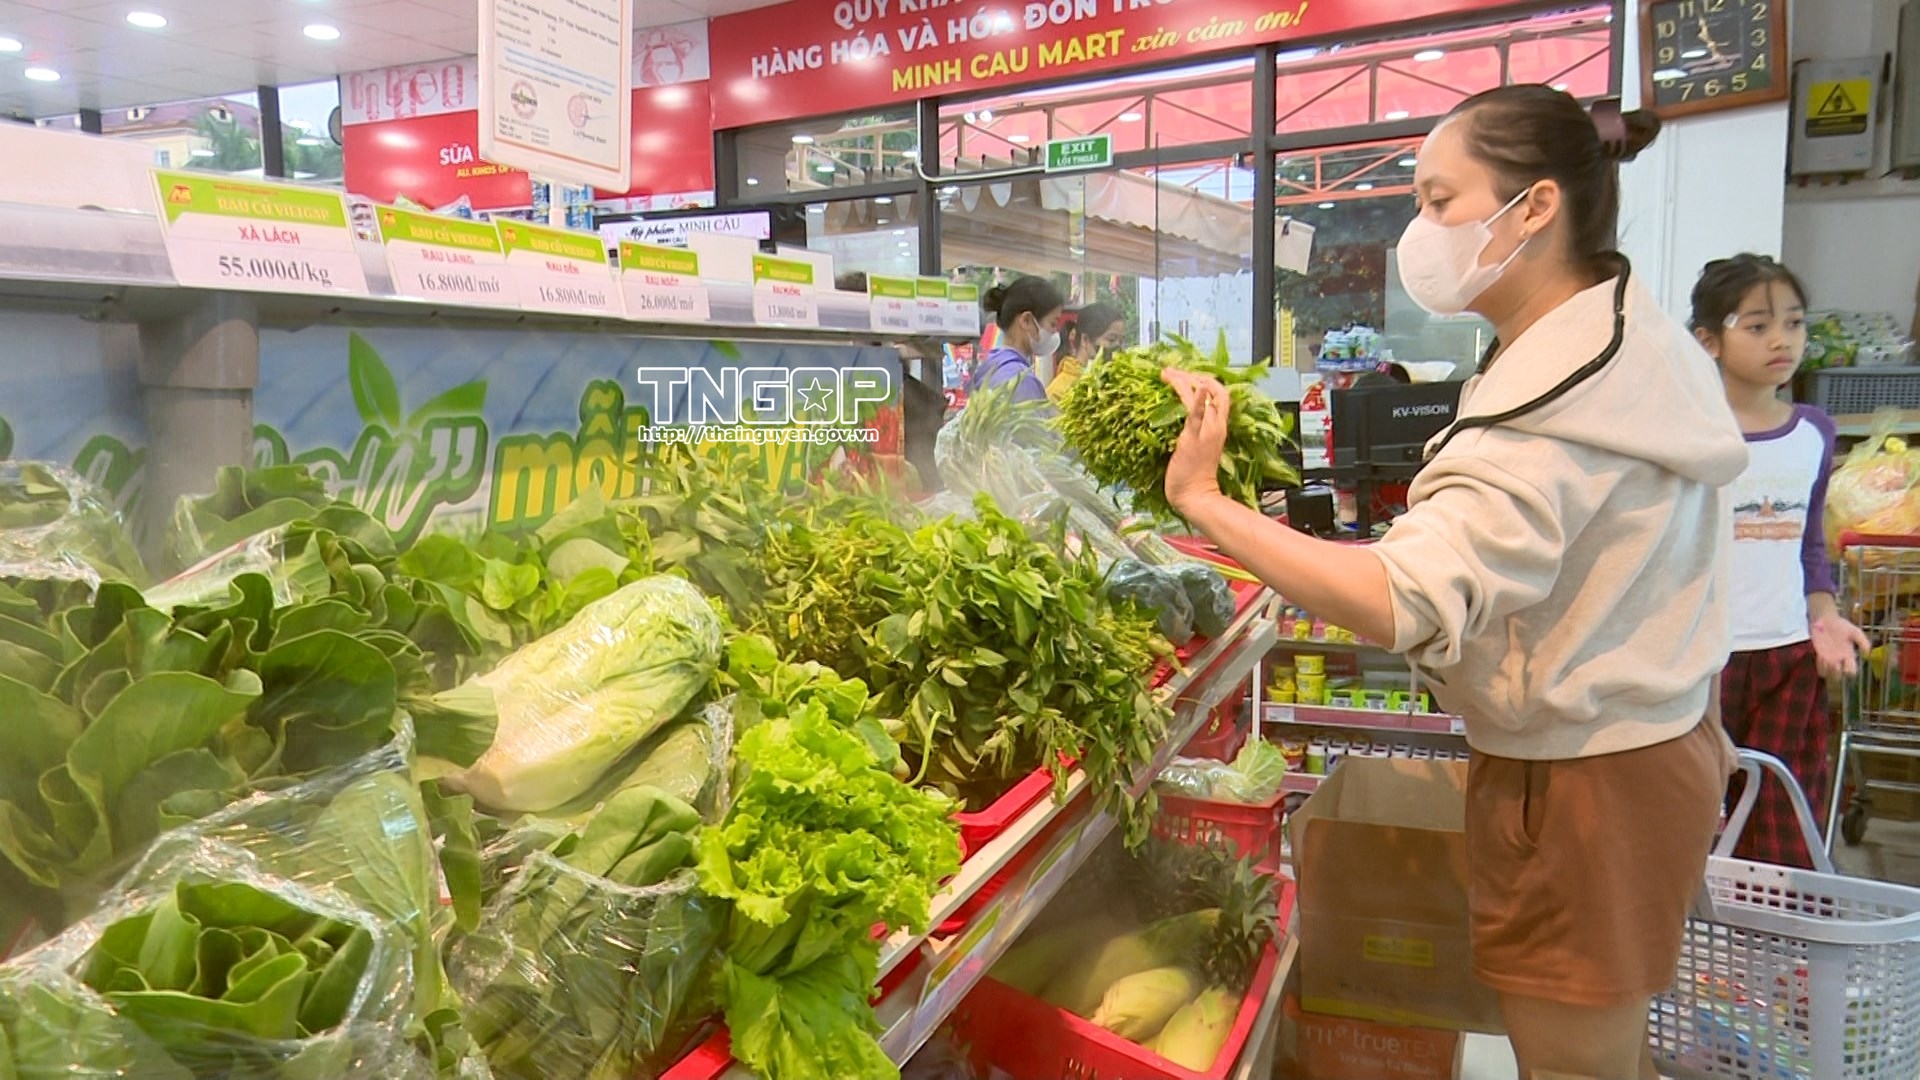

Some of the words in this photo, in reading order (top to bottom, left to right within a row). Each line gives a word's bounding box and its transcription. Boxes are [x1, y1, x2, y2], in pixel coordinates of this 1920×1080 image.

[1679, 0, 1694, 18] 11
[1751, 2, 1767, 21] 2
[1657, 19, 1677, 38] 10
[1751, 28, 1767, 47] 3
[751, 46, 823, 79] HÀNG
[831, 30, 891, 64] HÓA
[897, 18, 939, 52] VÀ
[947, 6, 1017, 44] HÓA
[892, 58, 962, 92] MINH
[970, 47, 1029, 79] CAU
[1038, 28, 1125, 69] MART
[1131, 27, 1181, 53] xin
[1187, 16, 1247, 43] cảm
[1254, 2, 1309, 33] ơn!
[1659, 46, 1675, 64] 9
[1751, 53, 1766, 71] 4
[1679, 81, 1695, 101] 7
[1704, 79, 1720, 97] 6
[1731, 73, 1747, 92] 5
[439, 142, 474, 166] SỮA
[1061, 141, 1096, 155] EXIT
[238, 224, 260, 241] XÀ
[264, 226, 301, 245] LÁCH
[678, 220, 711, 234] MINH
[421, 248, 445, 263] RAU
[218, 255, 333, 286] 55.000đ/kg
